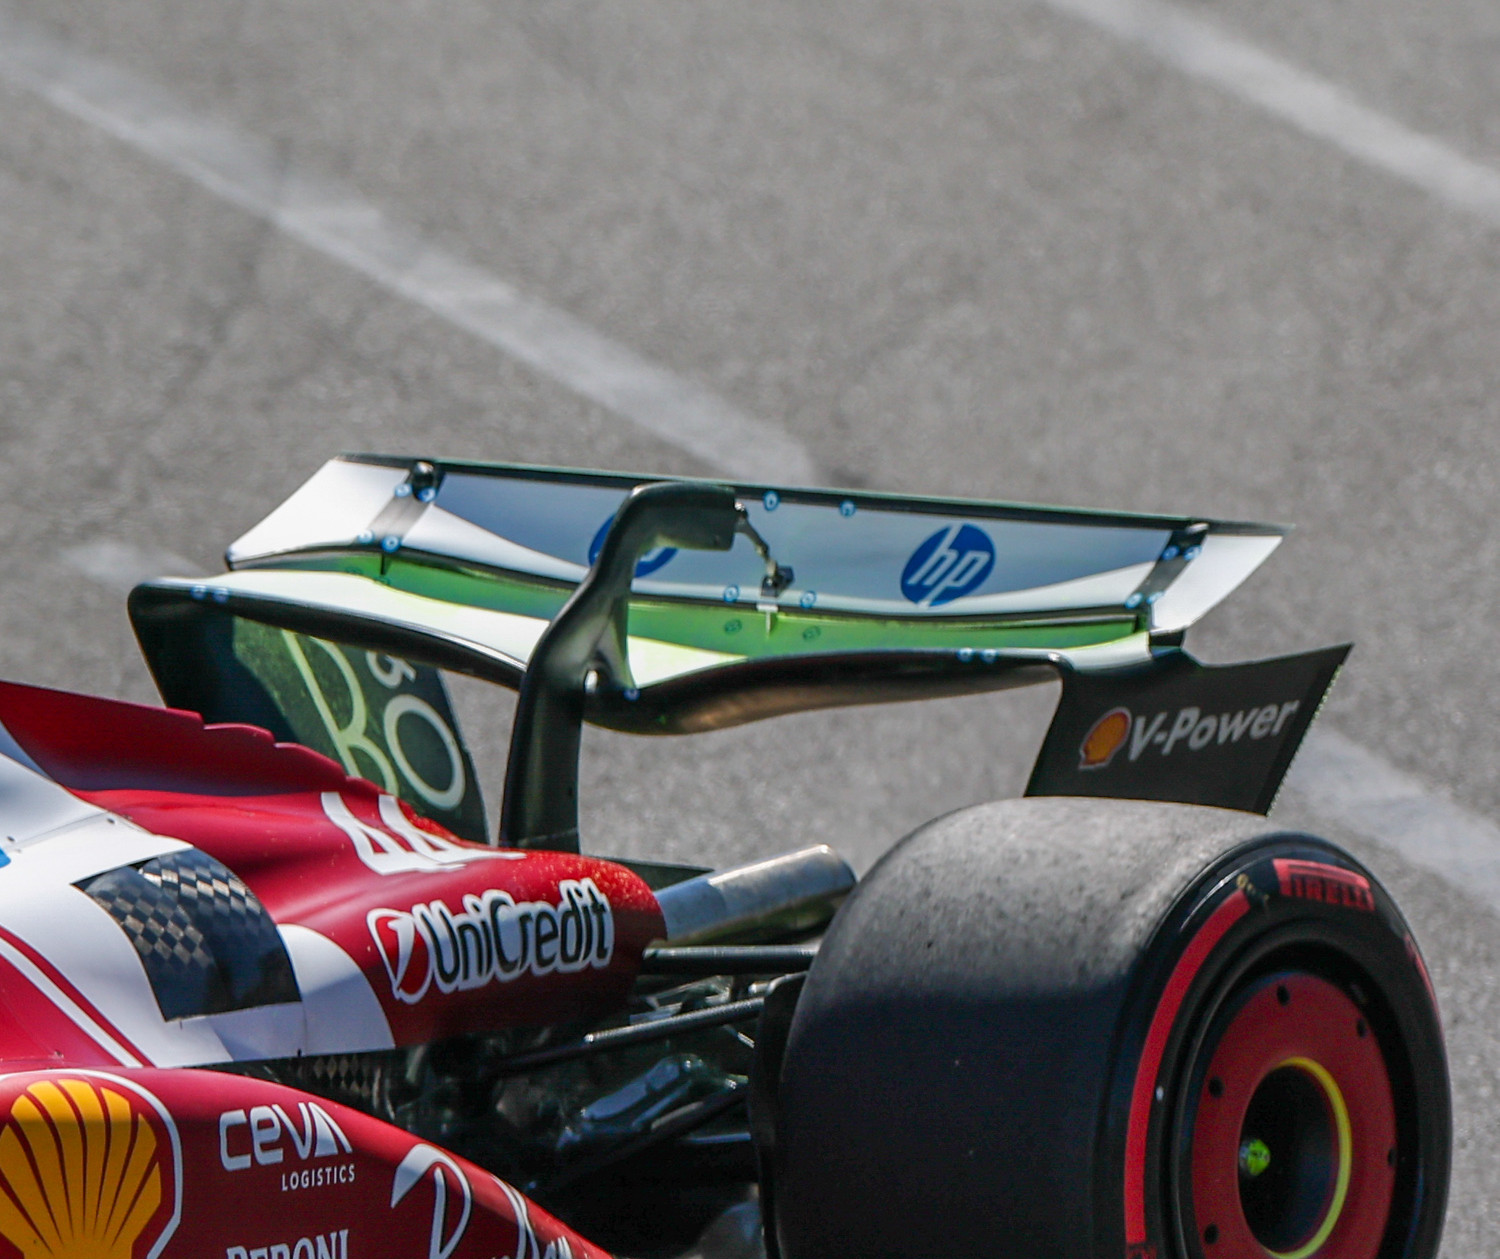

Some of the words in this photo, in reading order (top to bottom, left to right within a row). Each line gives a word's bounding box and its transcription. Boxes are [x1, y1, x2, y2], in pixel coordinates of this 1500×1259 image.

[906, 521, 992, 610] hp
[1127, 700, 1300, 762] V-Power
[1273, 858, 1376, 912] PIRELLI
[412, 877, 614, 994] UniCredit
[281, 1163, 356, 1192] LOGISTICS
